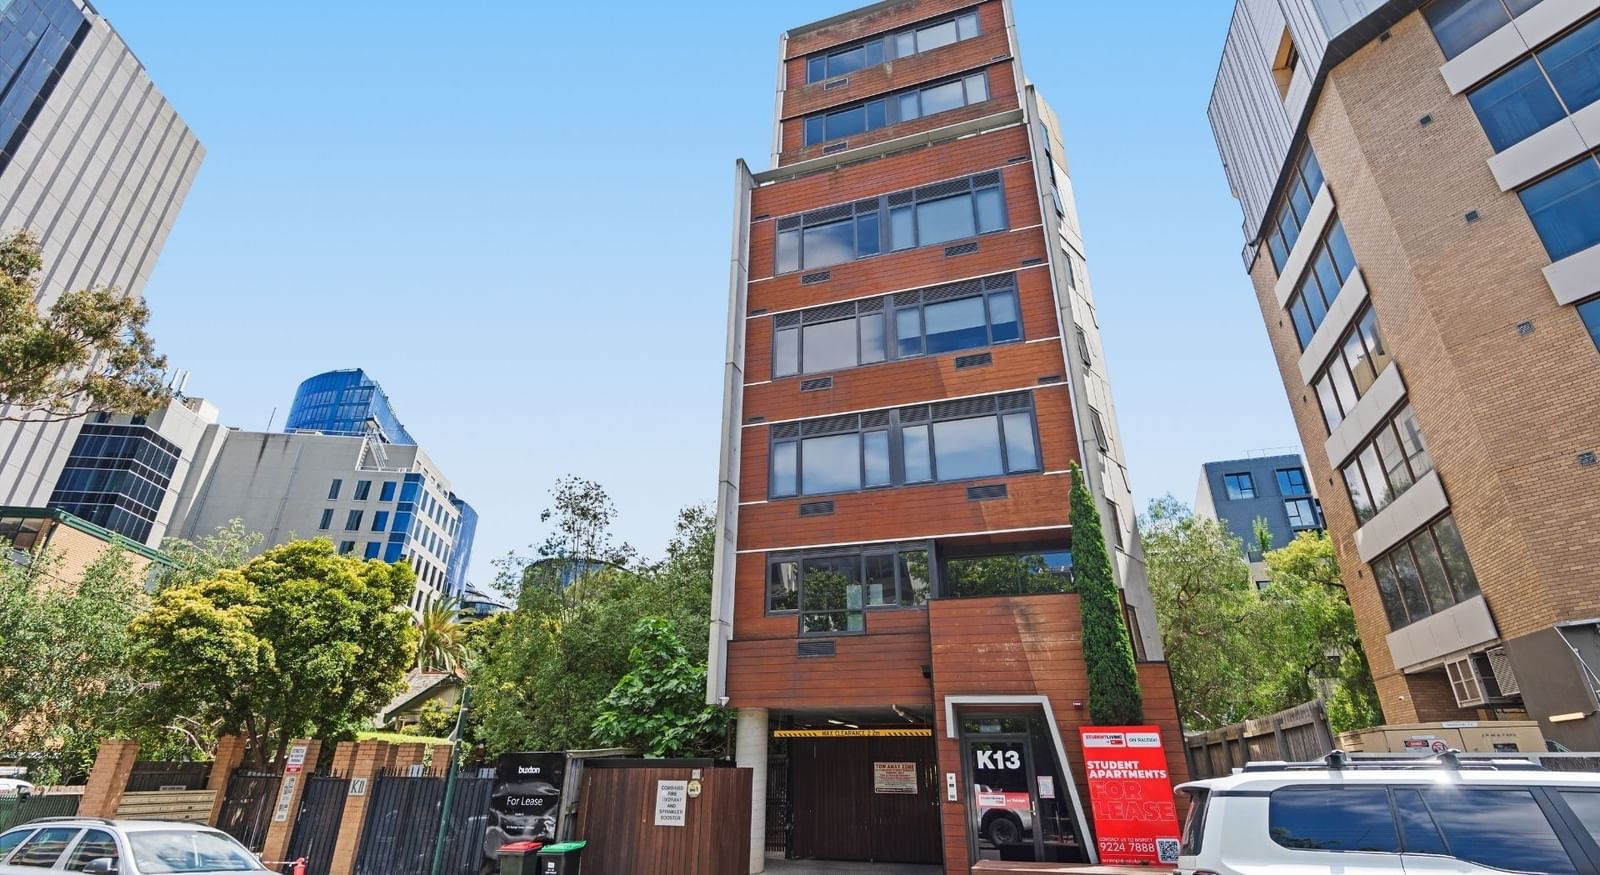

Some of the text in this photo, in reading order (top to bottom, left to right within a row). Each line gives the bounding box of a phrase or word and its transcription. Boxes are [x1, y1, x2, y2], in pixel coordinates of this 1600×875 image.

[977, 750, 1020, 769] K13
[1087, 760, 1139, 769] STUDENT
[518, 765, 541, 774] buxton
[1089, 769, 1167, 778] APARTMENTS
[1090, 780, 1143, 800] FOR
[507, 796, 544, 805] For Lease
[1093, 800, 1177, 821] LEASE
[1100, 842, 1155, 853] 9224 7888
